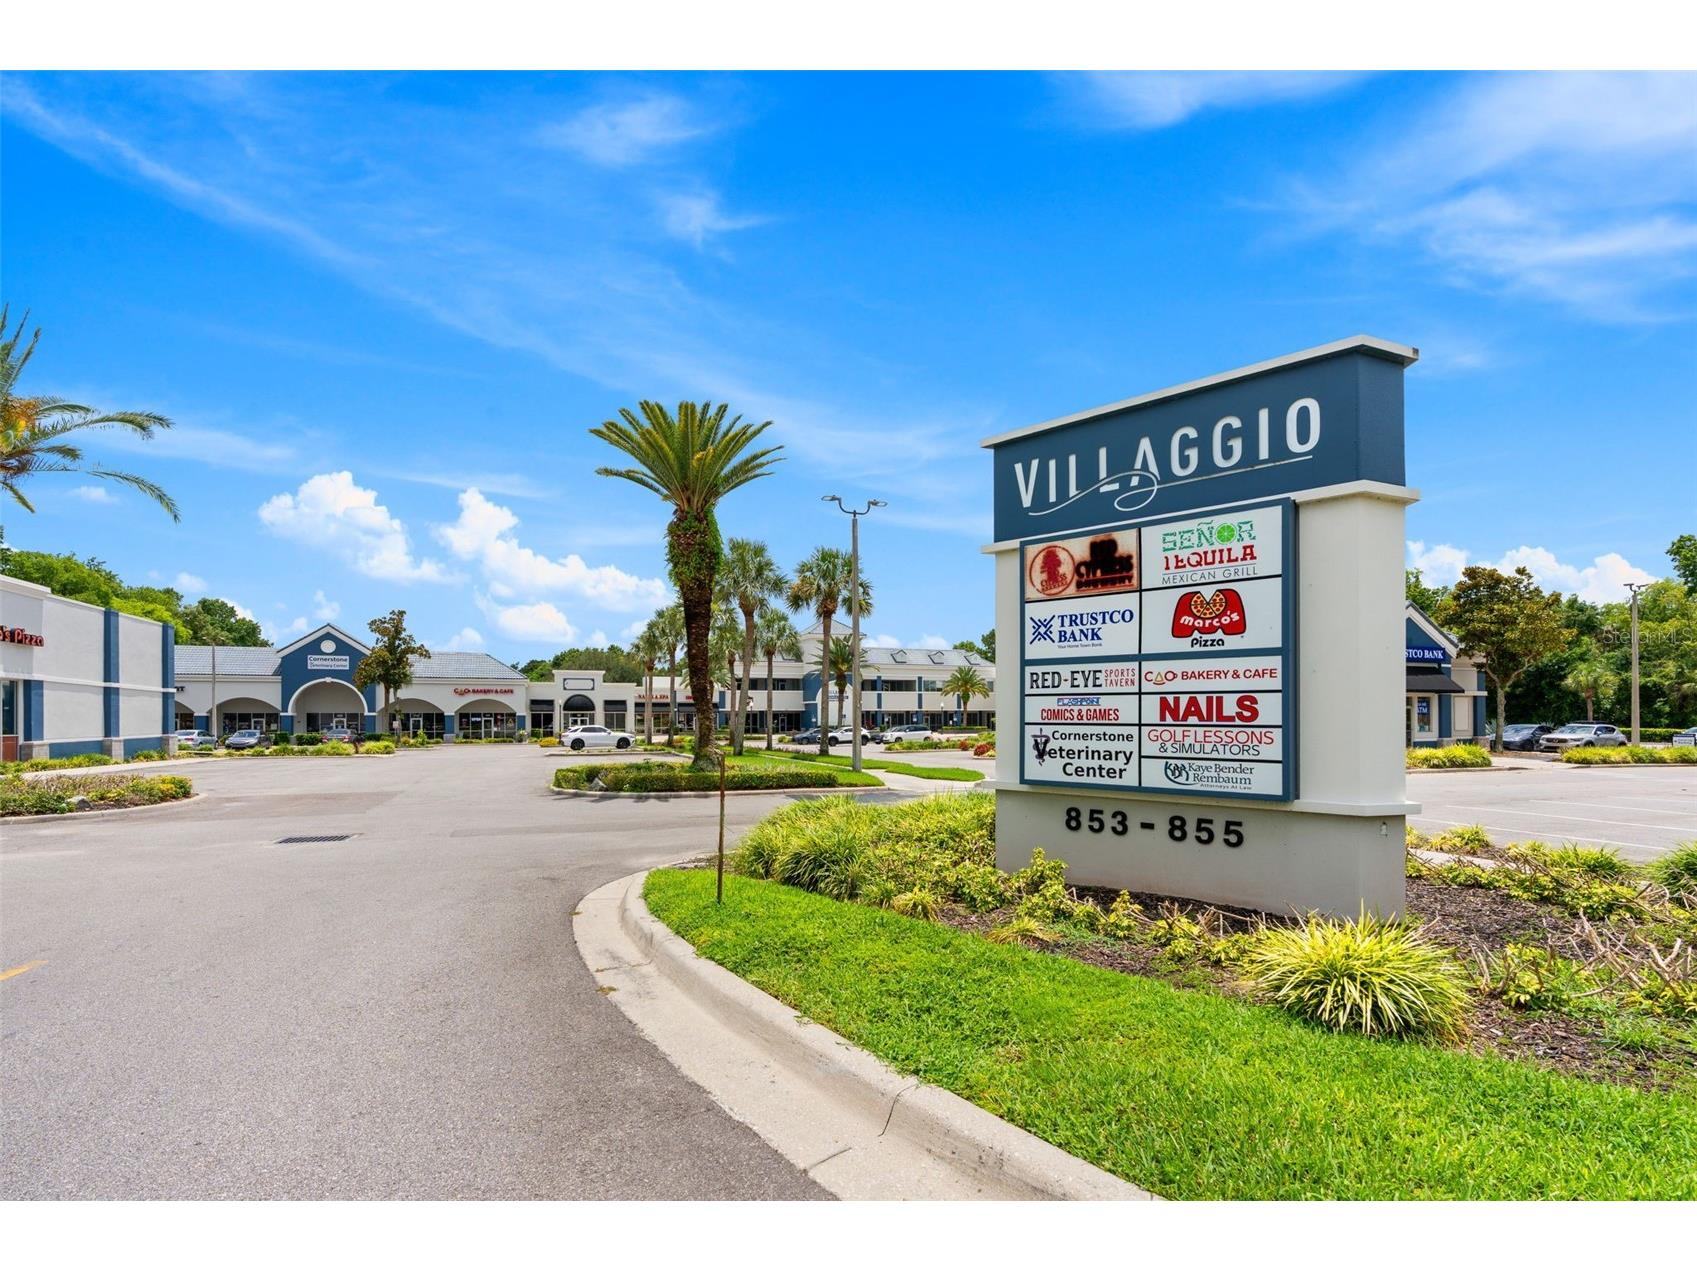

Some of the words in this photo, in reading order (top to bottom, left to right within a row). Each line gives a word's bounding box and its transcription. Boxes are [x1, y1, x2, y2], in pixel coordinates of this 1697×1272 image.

[1014, 397, 1321, 509] VILLAGGIO
[1163, 544, 1257, 571] TEQUILA
[1162, 571, 1217, 585] MEXICAN
[1222, 565, 1258, 578] GRILL
[1057, 608, 1134, 627] TRUSTCO
[1179, 610, 1240, 627] marco's
[14, 628, 45, 647] Pizza
[1057, 627, 1102, 643] BANK
[1190, 636, 1225, 648] Pizza
[1424, 649, 1444, 659] BANK
[1029, 669, 1103, 689] RED-EYE
[1104, 668, 1136, 678] SPORTS
[1181, 669, 1230, 680] BAKERY
[1231, 669, 1240, 679] &
[1243, 668, 1278, 679] CAFE
[1104, 678, 1136, 687] TAVERN
[1040, 708, 1075, 721] COMICS
[1076, 708, 1085, 721] &
[1086, 708, 1120, 721] GAMES
[1159, 694, 1259, 723] NAILS
[1051, 730, 1134, 742] Cornerstone
[1147, 729, 1191, 743] GOLF
[1194, 730, 1274, 745] LESSONS
[1033, 739, 1133, 765] Veterinary
[1158, 743, 1168, 753] &
[1170, 743, 1260, 756] SIMULATORS
[1062, 762, 1127, 779] Center
[1188, 762, 1213, 774] Kaye
[1214, 763, 1255, 775] Bender
[1193, 772, 1252, 785] Rembaum
